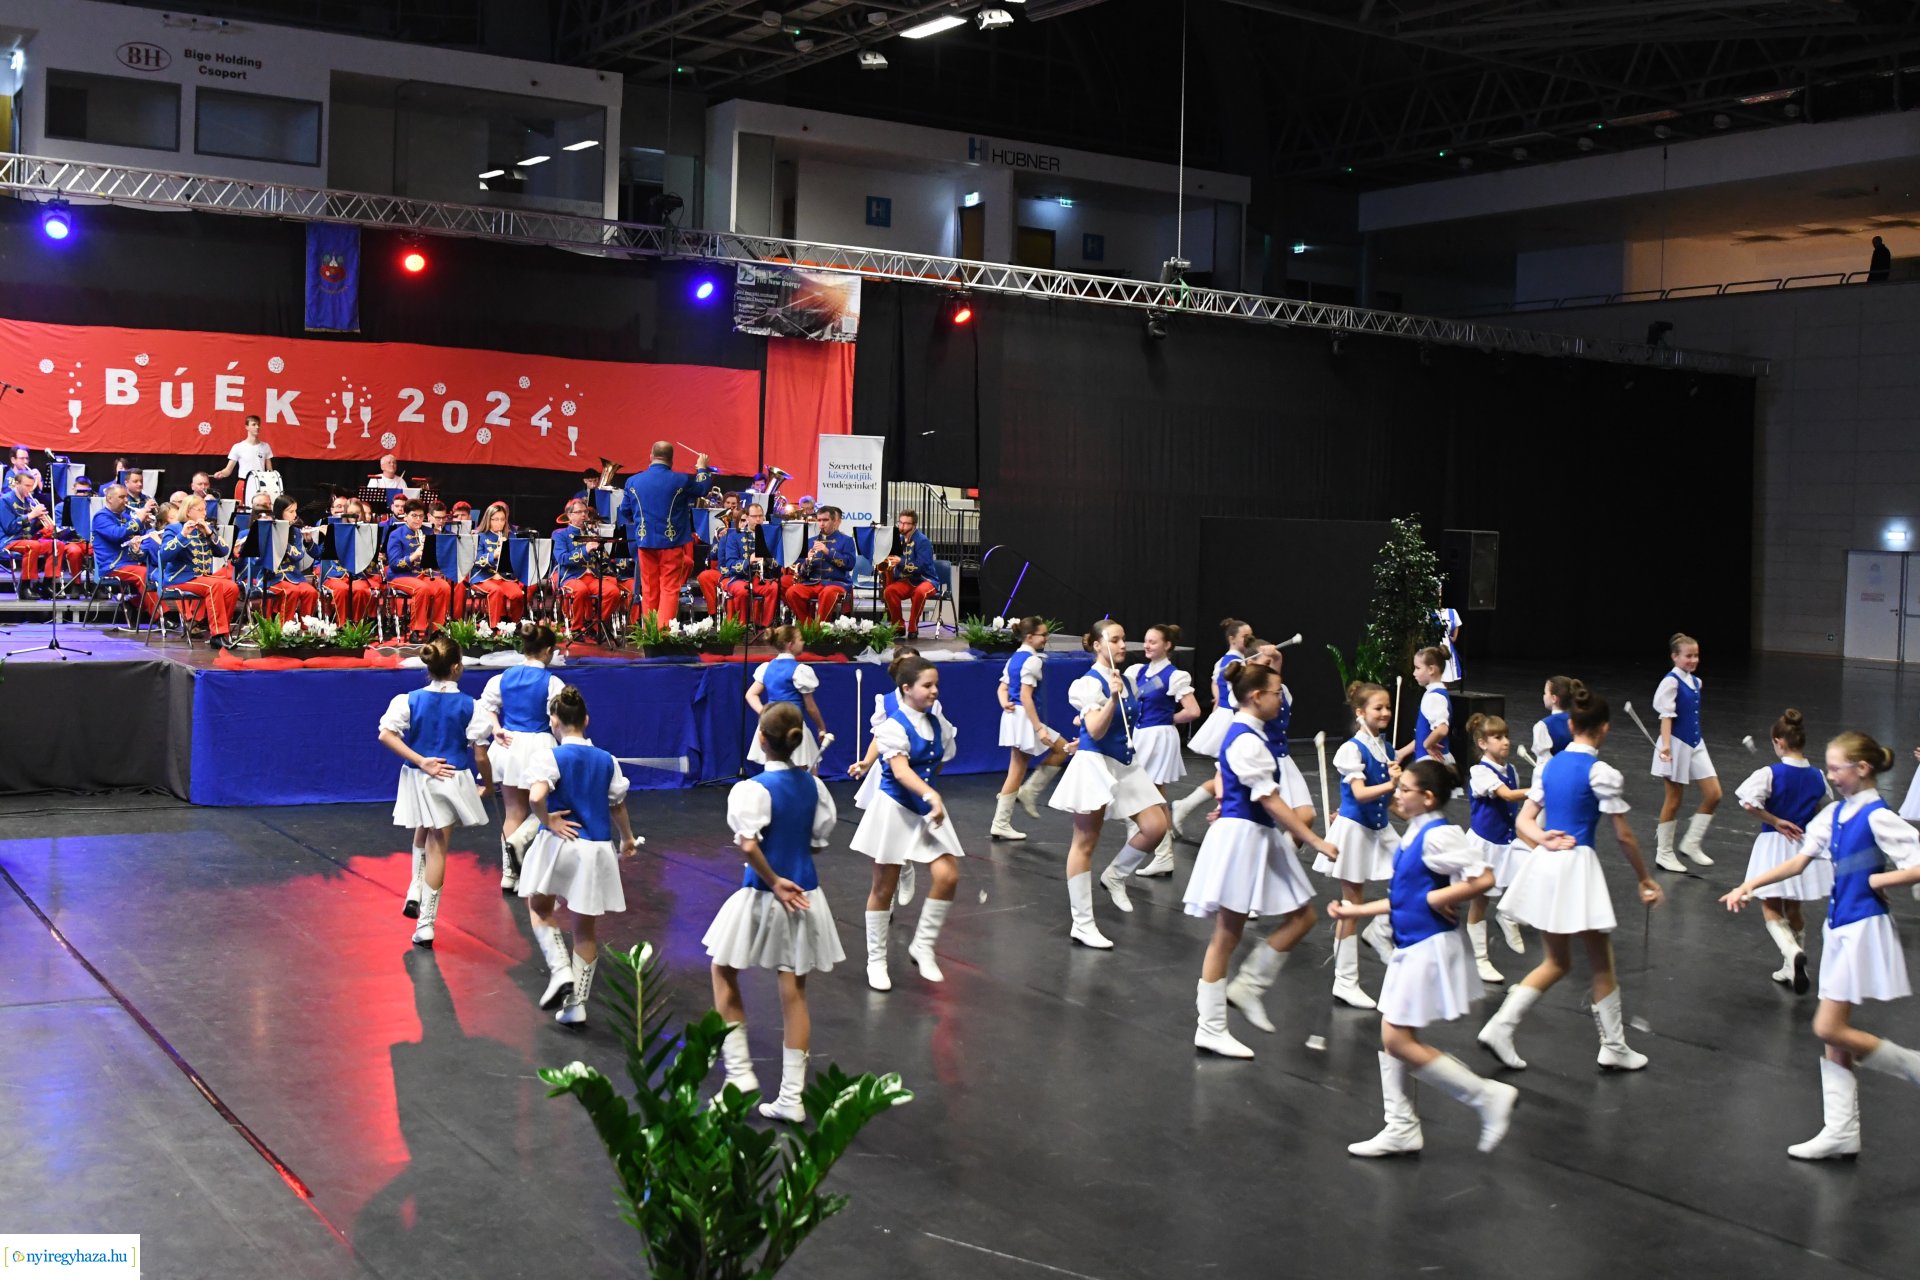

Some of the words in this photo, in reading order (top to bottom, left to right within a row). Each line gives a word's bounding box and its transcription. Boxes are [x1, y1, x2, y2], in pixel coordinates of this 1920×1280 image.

[128, 46, 161, 67] BH
[184, 49, 211, 61] Bige
[216, 53, 262, 69] Holding
[198, 65, 247, 80] Csoport
[992, 148, 1060, 172] HÜBNER
[105, 361, 301, 426] BÚÉK
[398, 387, 552, 437] 2024
[828, 461, 873, 471] Szeretettel
[828, 471, 873, 481] köszöntjük
[822, 481, 877, 490] vendégeinket!
